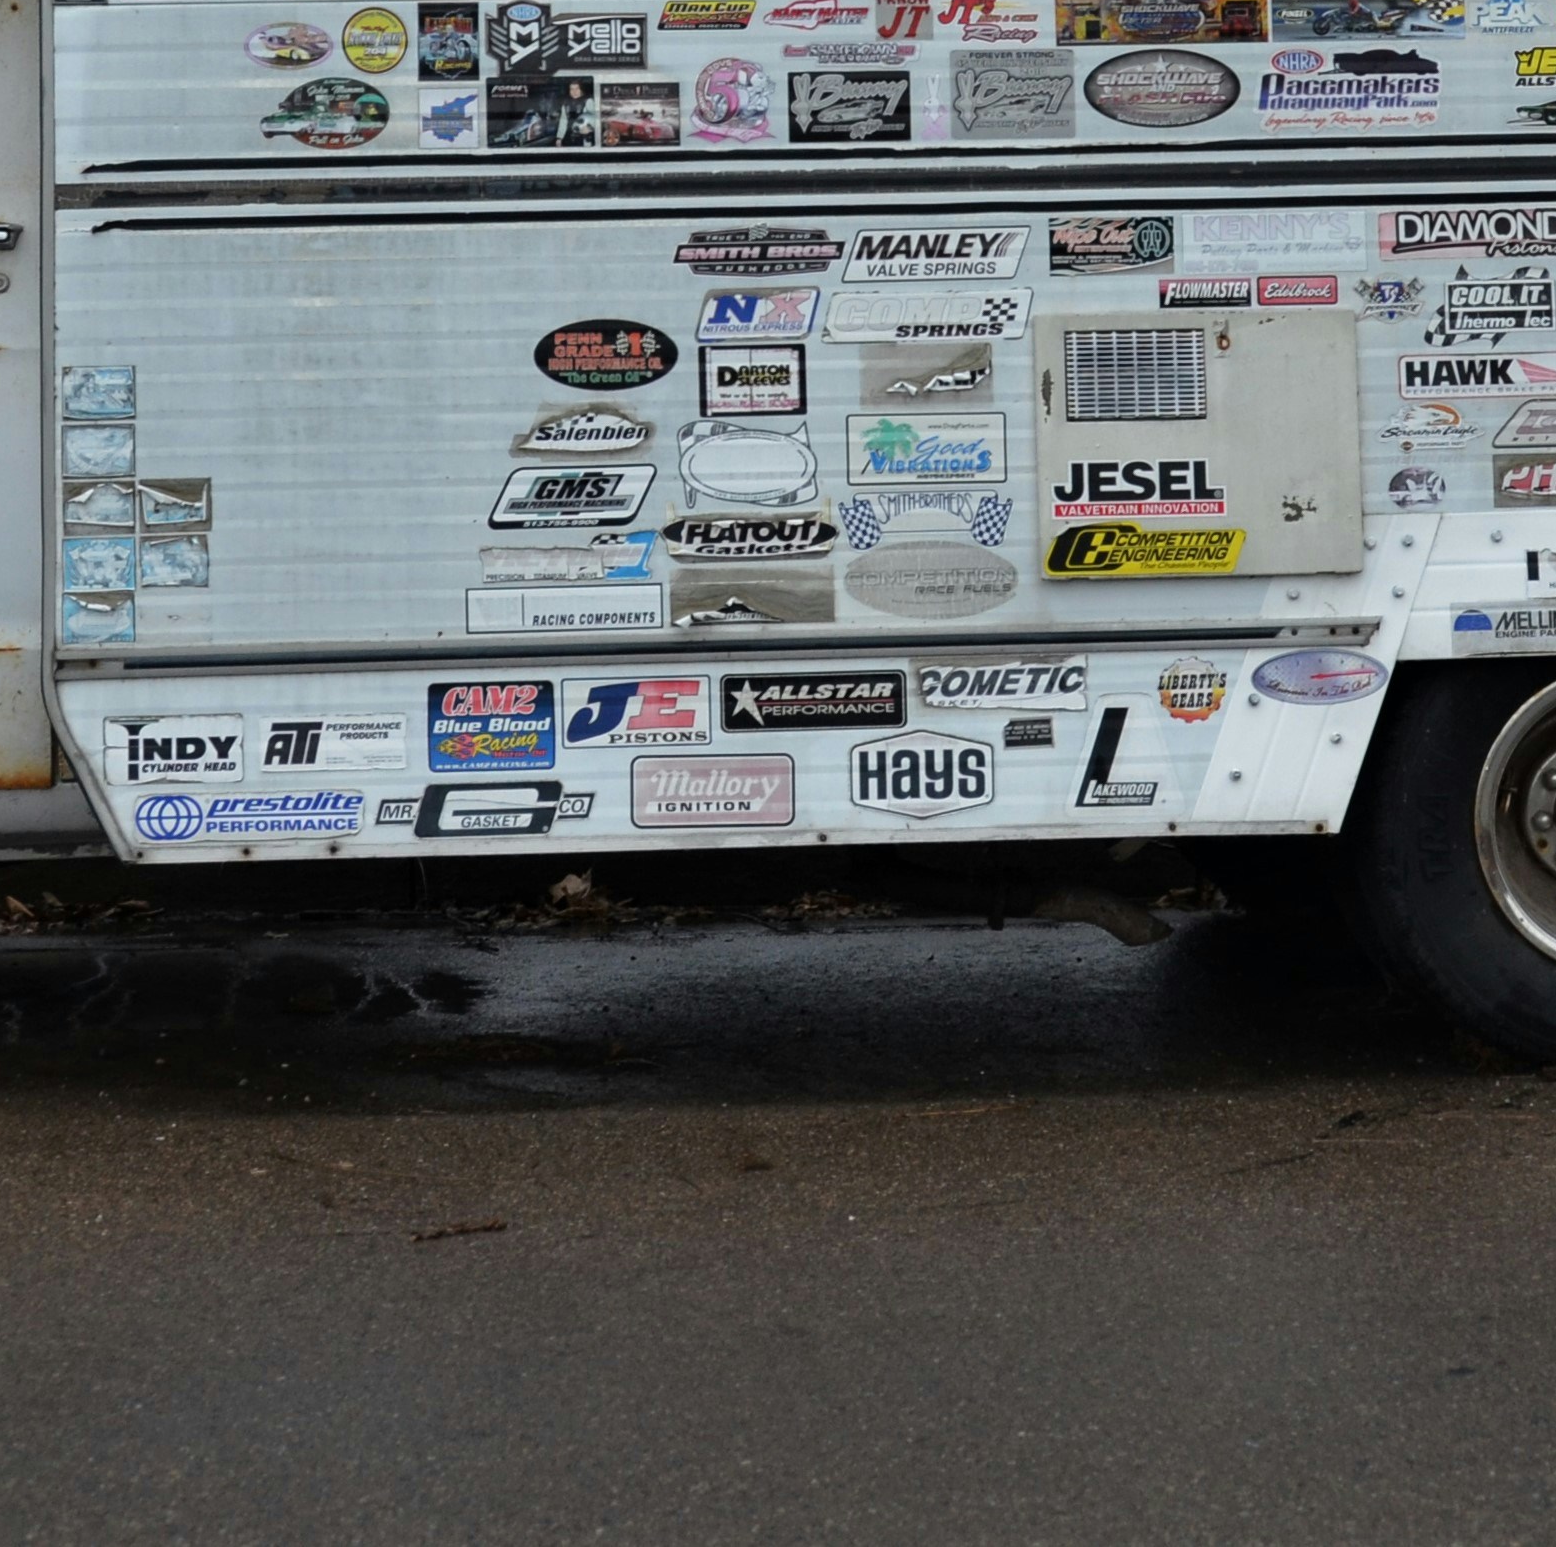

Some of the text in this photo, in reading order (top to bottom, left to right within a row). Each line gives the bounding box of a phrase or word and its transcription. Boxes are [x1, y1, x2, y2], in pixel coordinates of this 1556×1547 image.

[678, 244, 840, 260] SMITH BROS.
[854, 233, 998, 260] MANLEY
[866, 261, 997, 277] VALVE SPRINGS
[1164, 281, 1249, 306] FLOWMASTER
[1264, 282, 1332, 299] Edelbrock
[1452, 285, 1542, 306] COOL IT
[1405, 359, 1517, 387] HAWK
[535, 477, 610, 499] GMS
[1054, 461, 1225, 502] JESEL
[1059, 502, 1219, 516] VALVETRAIN INNOVATION
[1115, 532, 1235, 547] COMPETITION
[1108, 548, 1230, 562] ENGINEERING
[1527, 550, 1540, 580] I
[1495, 628, 1537, 638] ENGINE
[921, 665, 1085, 698] COMETIC
[758, 681, 894, 701] ALLSTAR
[443, 684, 539, 716] CAM2
[761, 701, 896, 717] PERFORMANCE
[325, 721, 402, 732] PERFORMANCE
[434, 716, 551, 733] Blue Blood
[339, 730, 389, 741] PRODUCTS
[608, 729, 709, 745] PISTONS
[142, 761, 237, 774] CYLINDER HEAD
[1082, 780, 1154, 805] LAKEWOOD
[207, 792, 364, 821] prestolite
[656, 801, 751, 813] IGNITION
[205, 817, 359, 833] PERFORMANCE
[460, 814, 522, 830] GASKET
